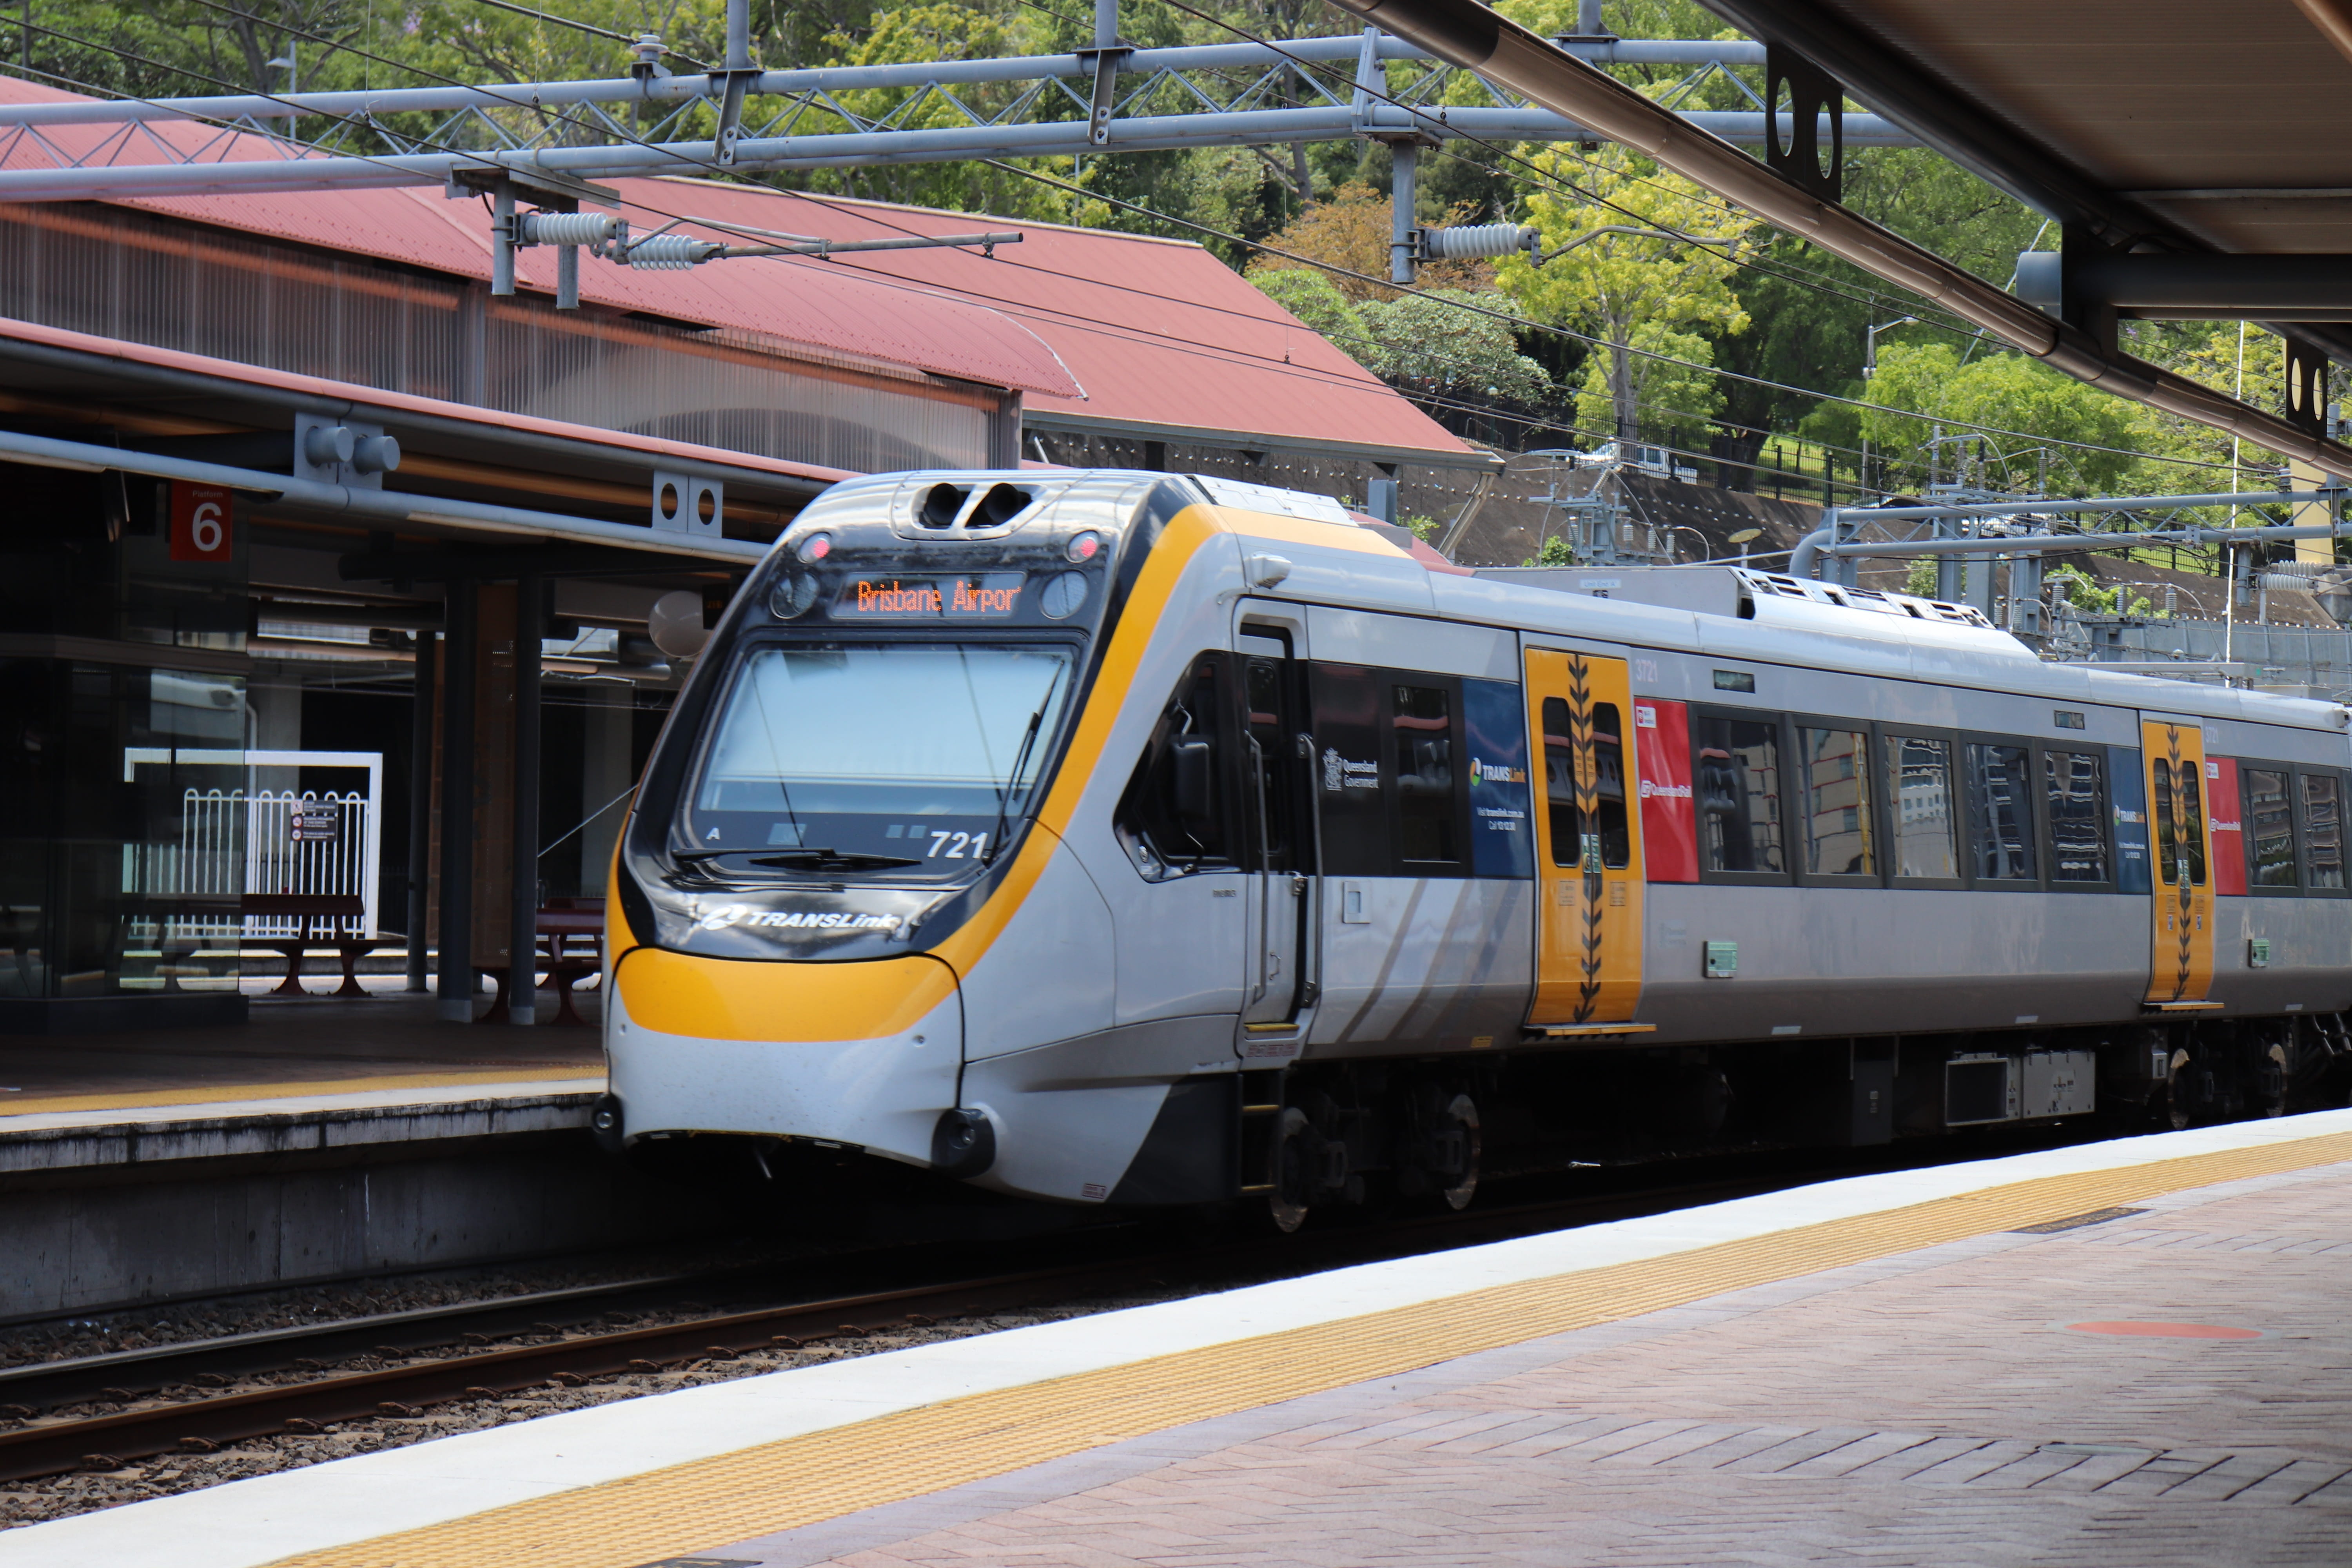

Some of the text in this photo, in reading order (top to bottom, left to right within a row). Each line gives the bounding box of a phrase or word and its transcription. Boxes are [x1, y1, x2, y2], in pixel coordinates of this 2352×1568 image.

[192, 502, 222, 552] 6
[858, 580, 941, 612] Brisbane
[1343, 759, 1378, 773] Queensland
[1344, 774, 1379, 789] Government
[706, 827, 720, 840] A
[927, 831, 988, 859] 721
[747, 910, 900, 928] TRANSLink
